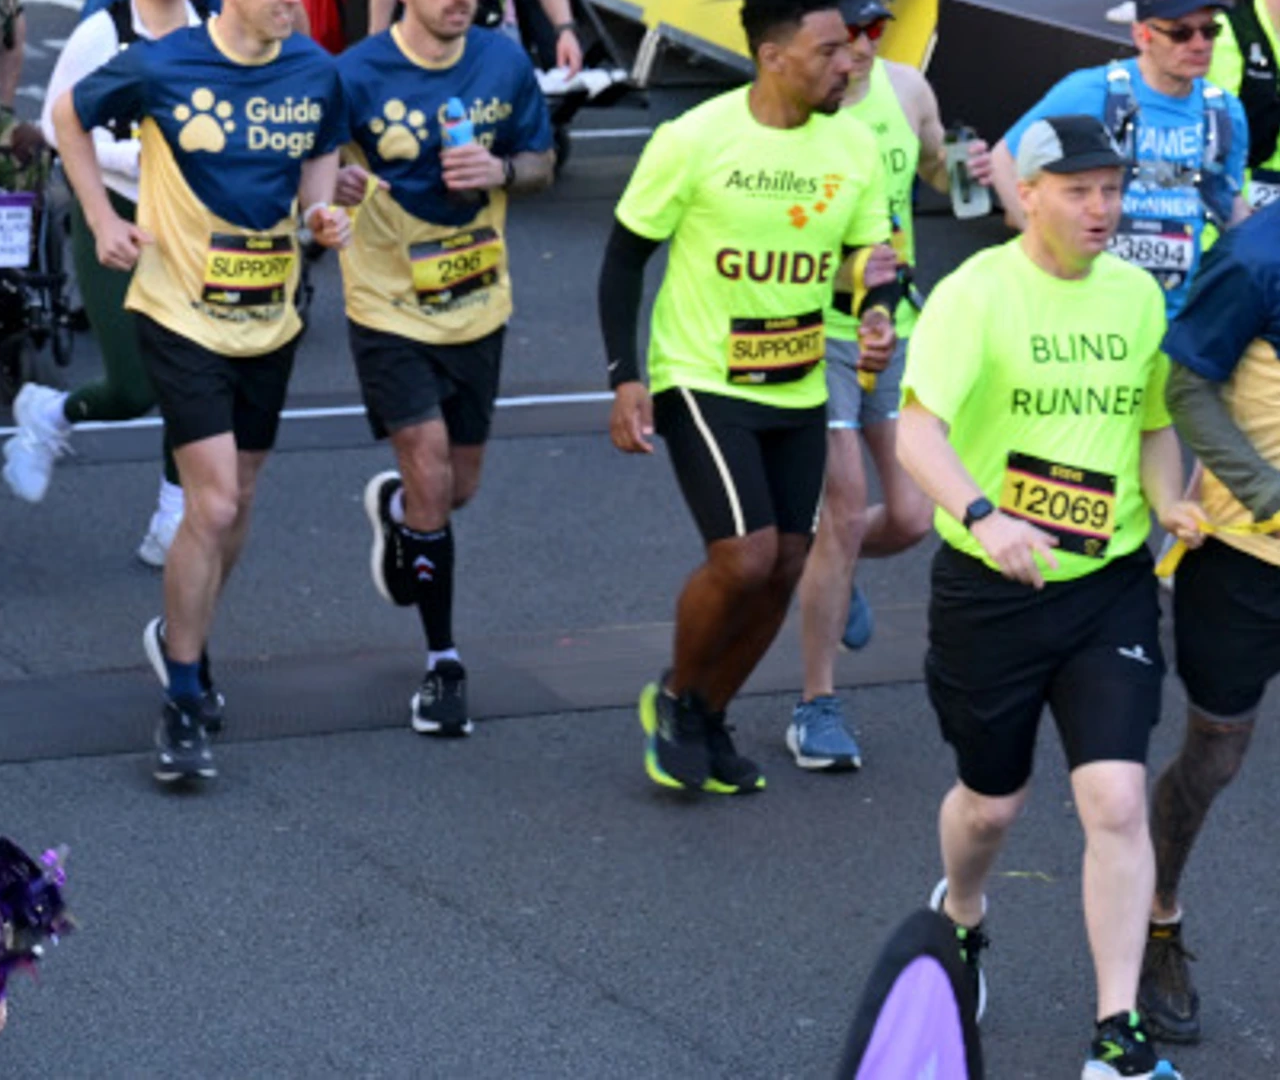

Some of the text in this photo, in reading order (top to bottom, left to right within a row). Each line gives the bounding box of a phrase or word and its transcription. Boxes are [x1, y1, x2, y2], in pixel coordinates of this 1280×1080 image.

[245, 96, 323, 124] Guide
[248, 125, 316, 157] Dogs
[725, 169, 818, 195] Achilles
[210, 256, 293, 280] SUPPORT
[715, 246, 832, 285] GUIDE
[732, 330, 822, 361] SUPPORT
[1031, 333, 1128, 363] BLIND
[1010, 480, 1109, 530] 12069
